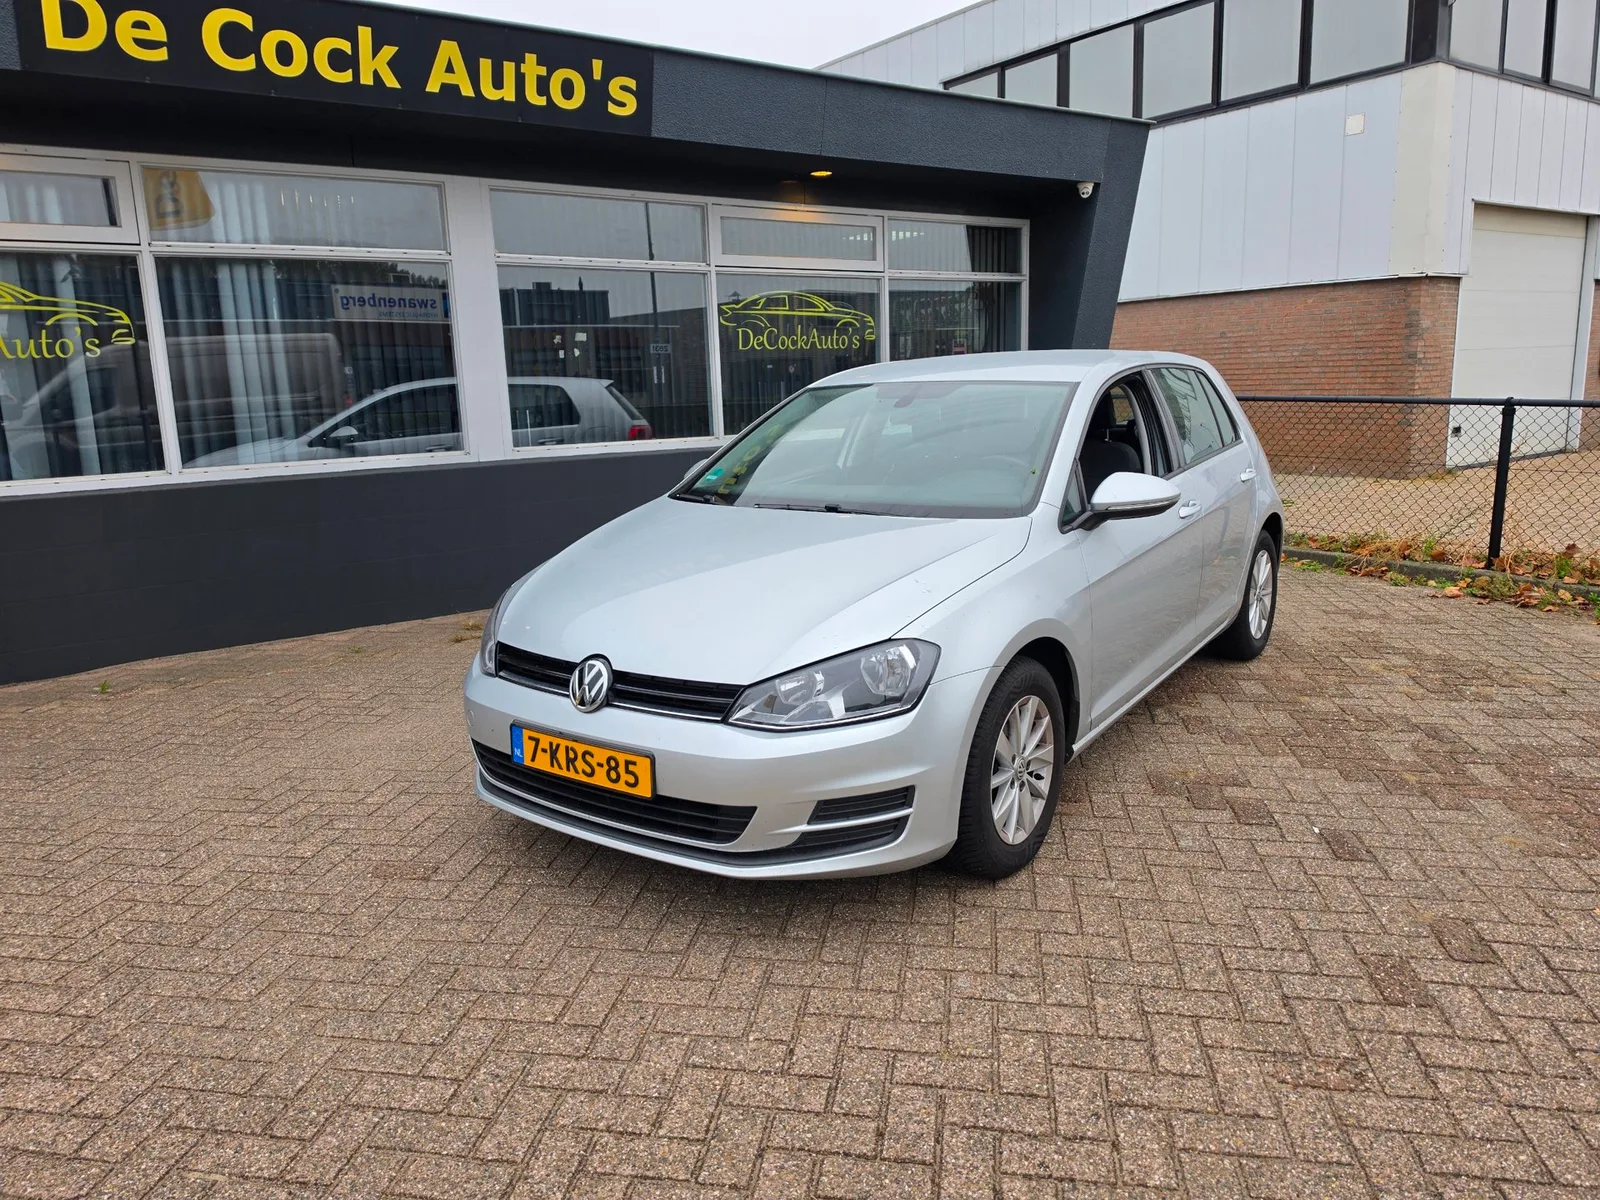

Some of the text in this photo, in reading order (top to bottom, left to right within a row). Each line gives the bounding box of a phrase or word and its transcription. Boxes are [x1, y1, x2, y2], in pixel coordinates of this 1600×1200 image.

[41, 0, 637, 116] De Cock Auto's
[736, 325, 860, 350] DeCockAuto's
[528, 735, 639, 788] 7-KRS-85
